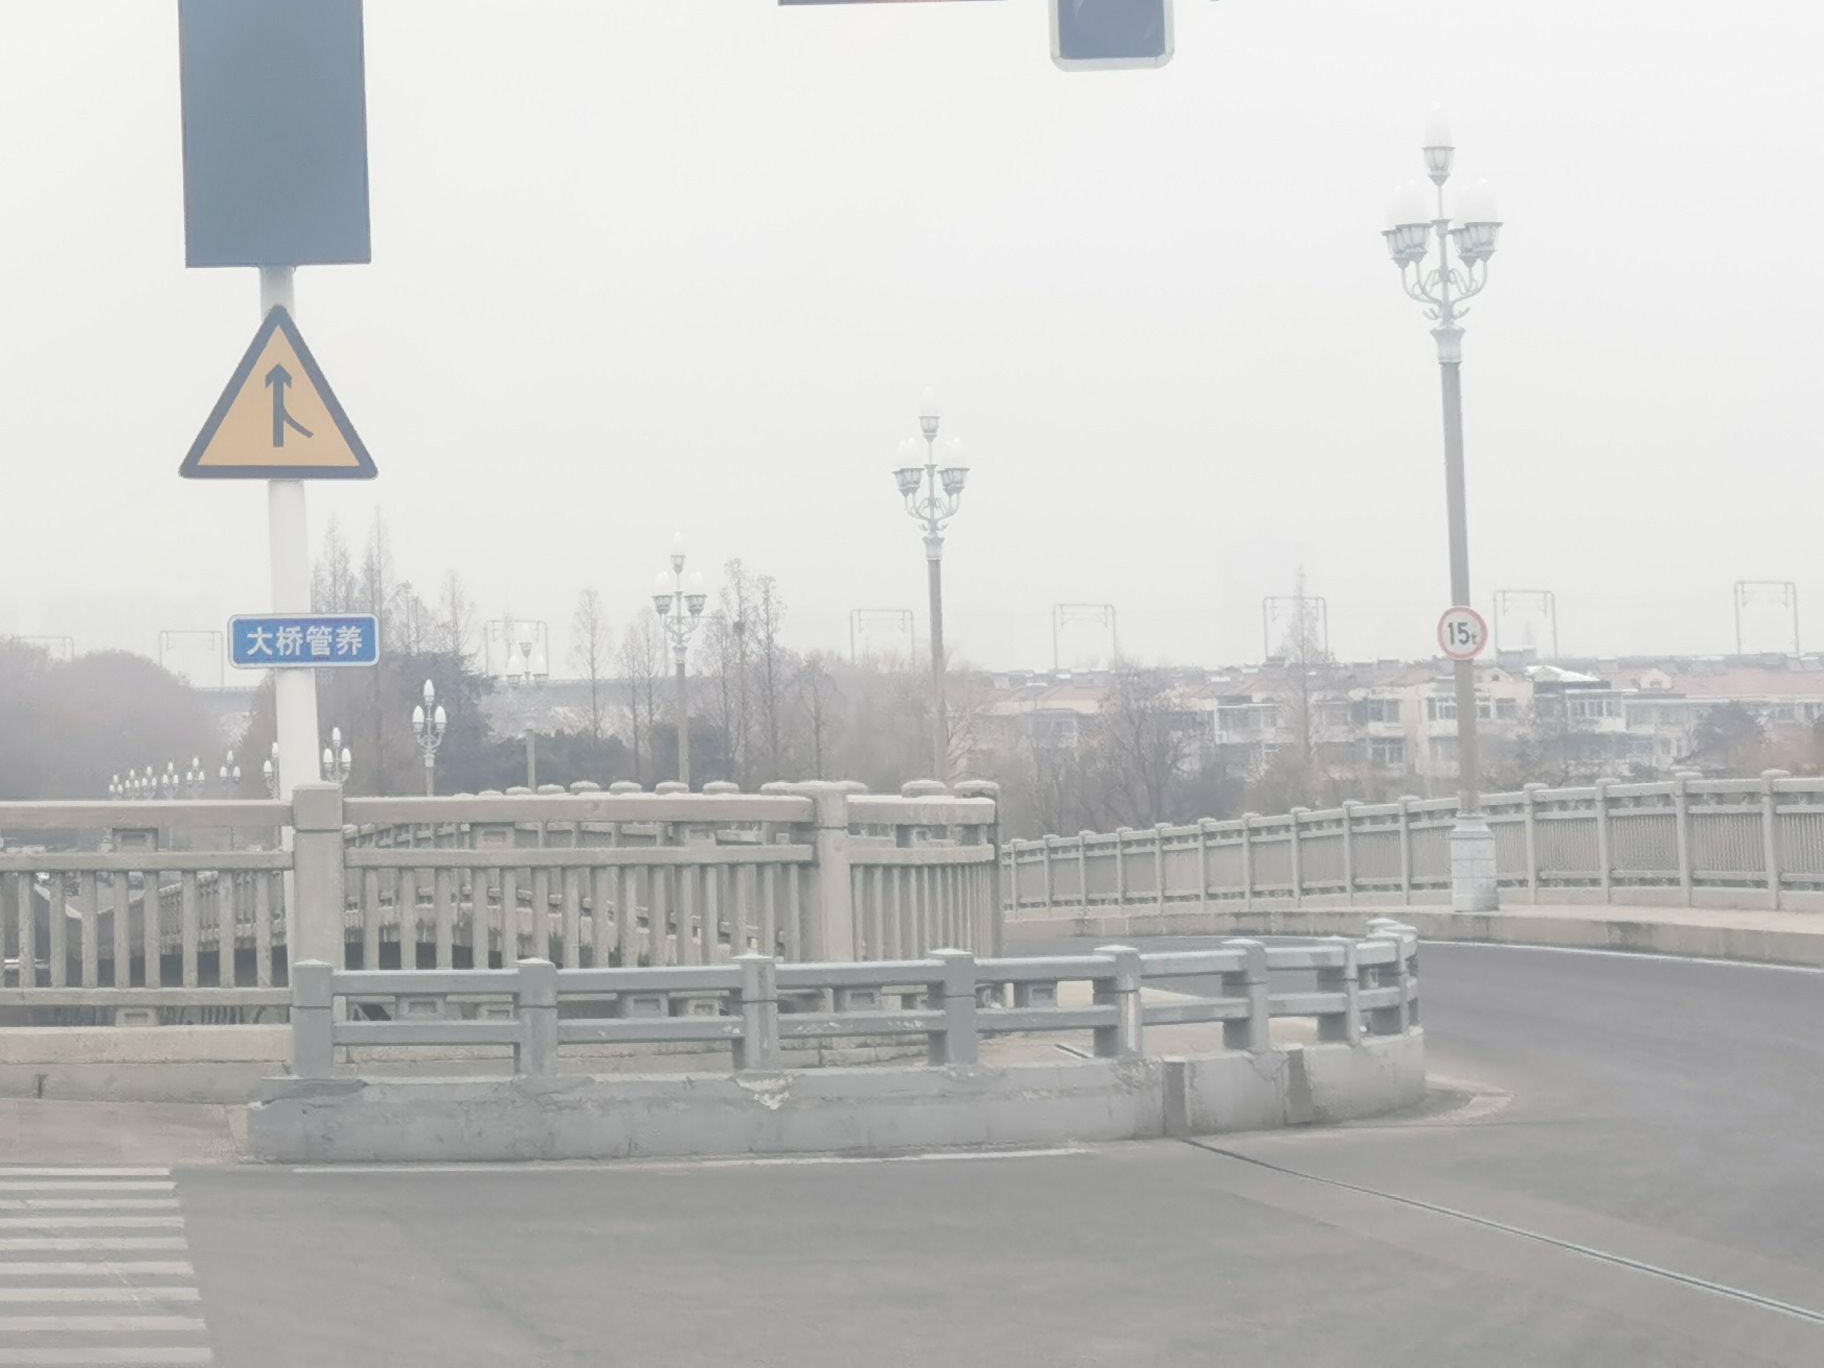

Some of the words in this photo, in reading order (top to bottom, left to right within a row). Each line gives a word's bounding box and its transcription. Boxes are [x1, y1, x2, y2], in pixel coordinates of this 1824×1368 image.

[246, 625, 363, 656] 大桥管养
[1448, 622, 1478, 645] 15t
